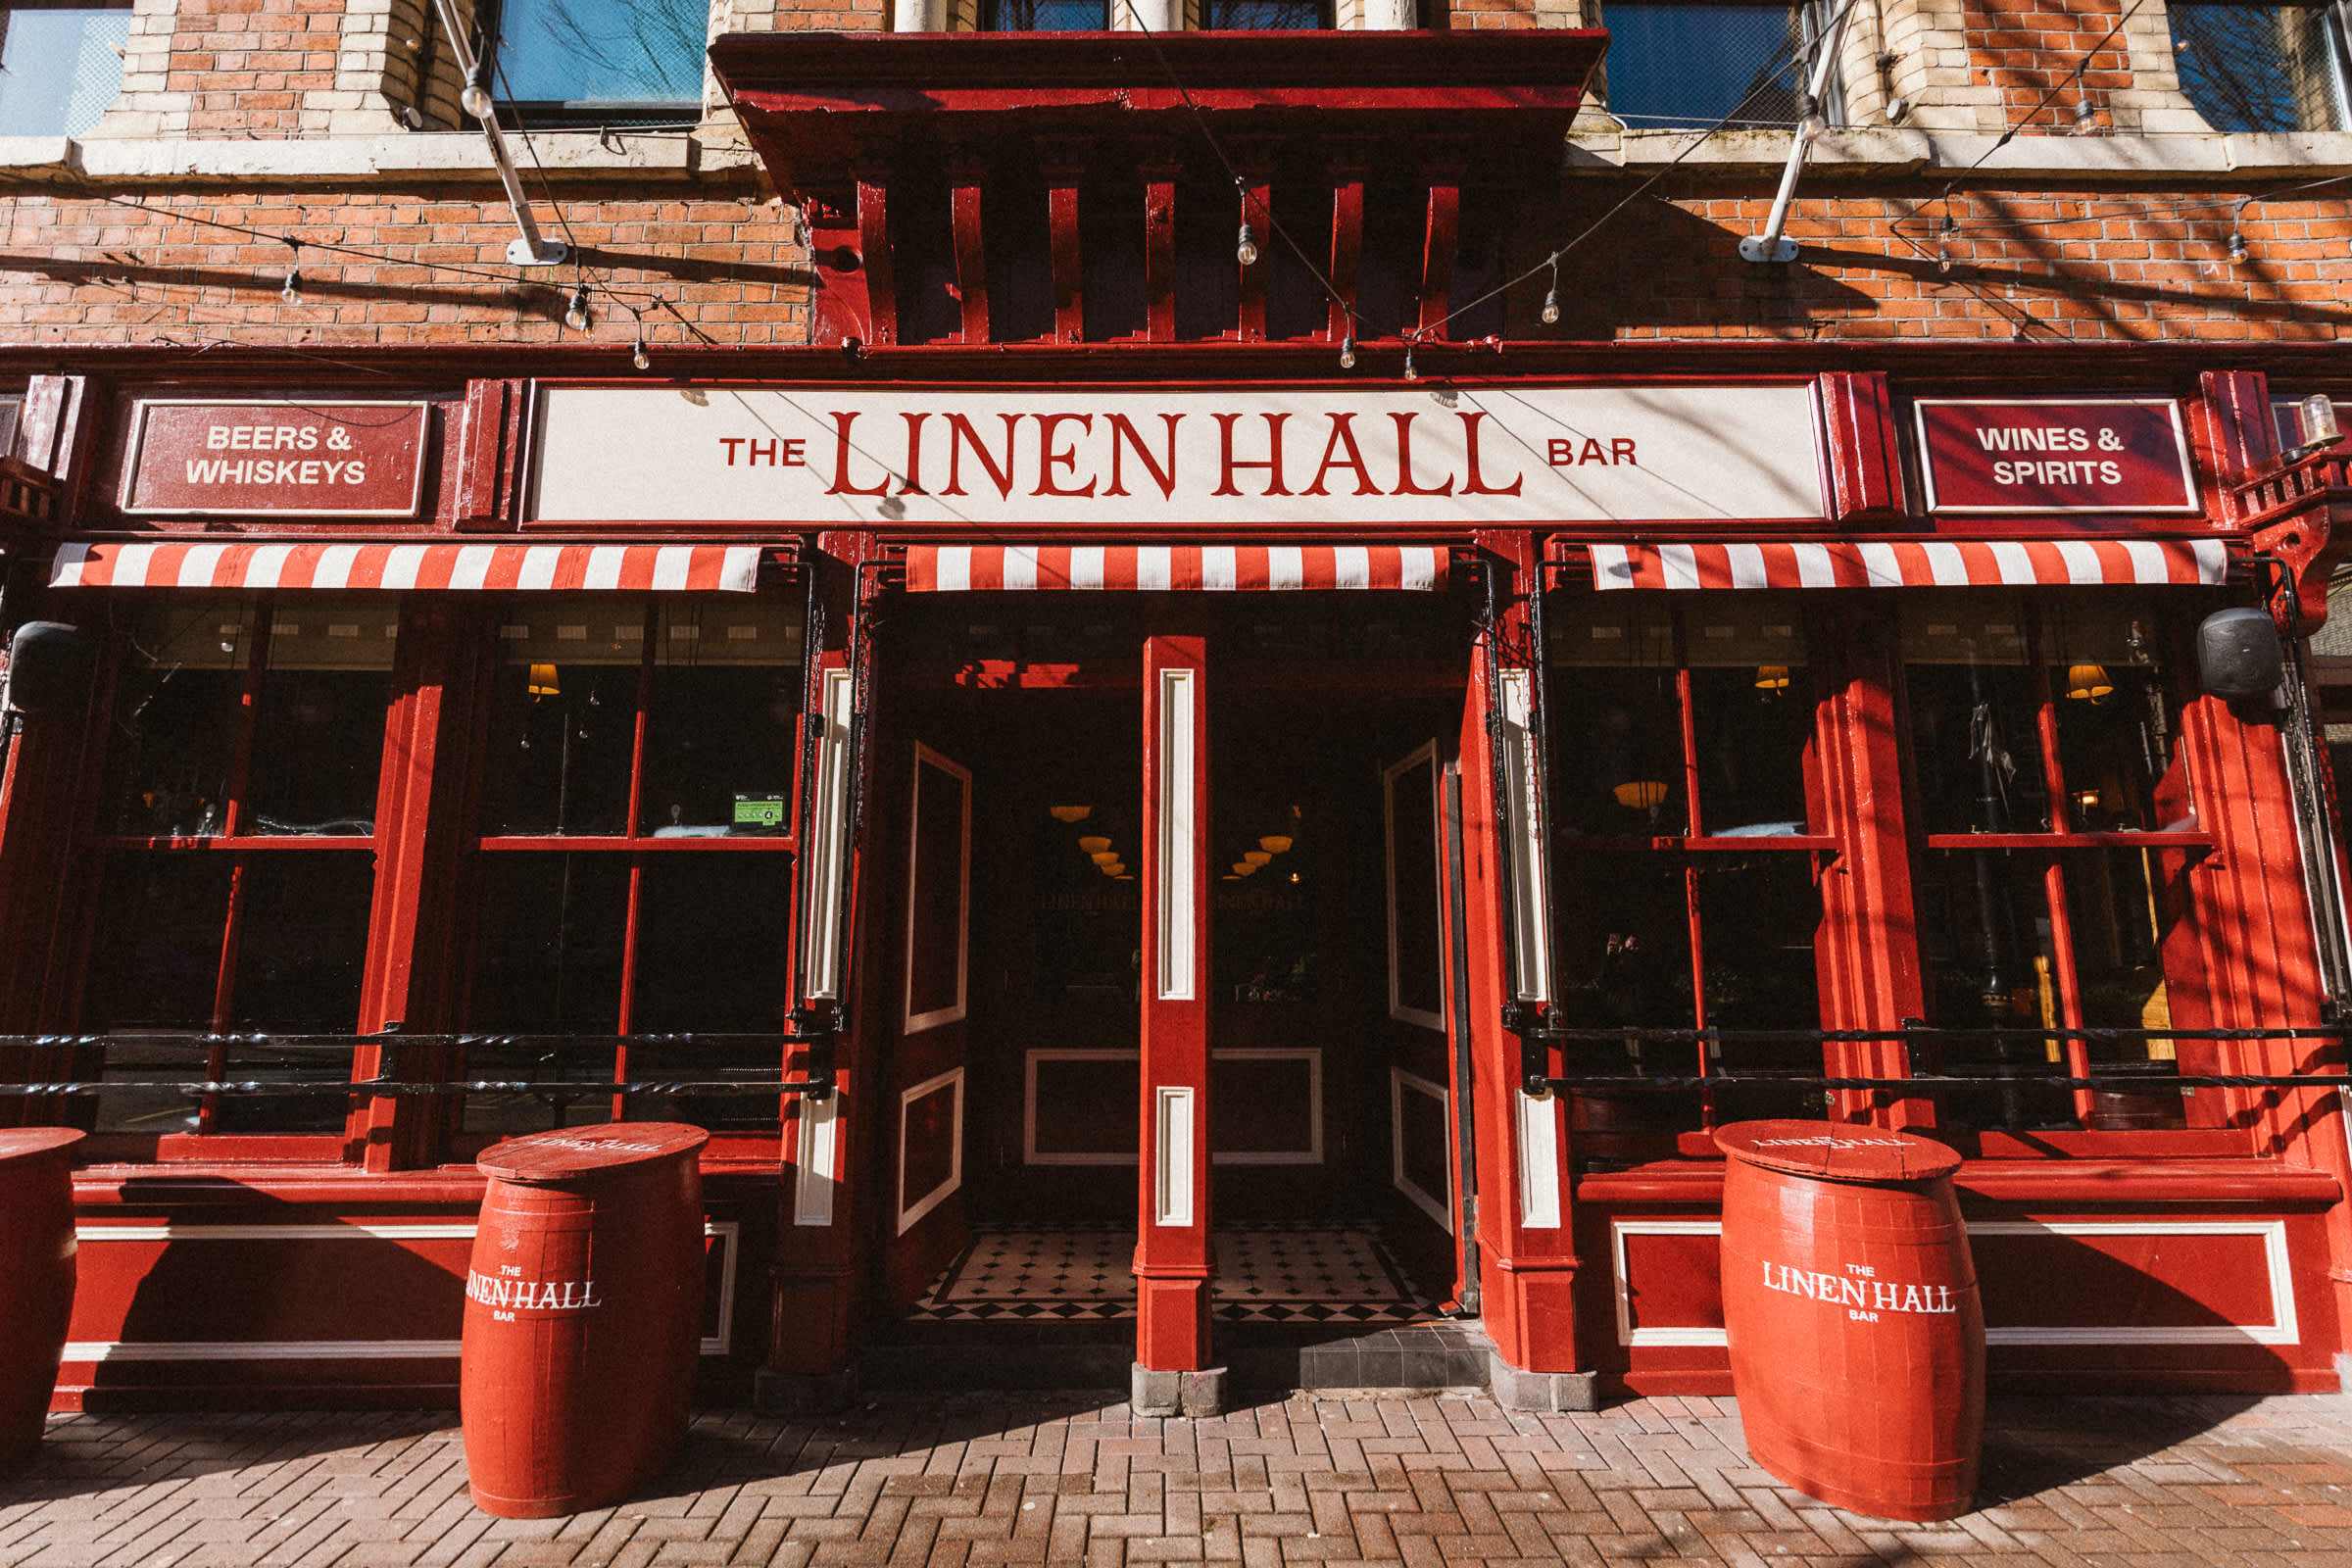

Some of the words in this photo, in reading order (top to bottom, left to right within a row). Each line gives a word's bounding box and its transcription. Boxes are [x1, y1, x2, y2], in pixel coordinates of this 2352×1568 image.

[206, 425, 318, 451] BEERS
[326, 425, 353, 451] &
[1976, 427, 2090, 452] WINES
[2097, 427, 2126, 452] &
[719, 438, 806, 466] THE
[1547, 438, 1638, 467] BAR
[185, 460, 366, 485] WHISKEYS
[1993, 460, 2123, 485] SPIRITS
[500, 1264, 521, 1277] THE
[1845, 1263, 1876, 1278] THE
[493, 1309, 515, 1323] BAR
[1848, 1308, 1879, 1323] BAR
